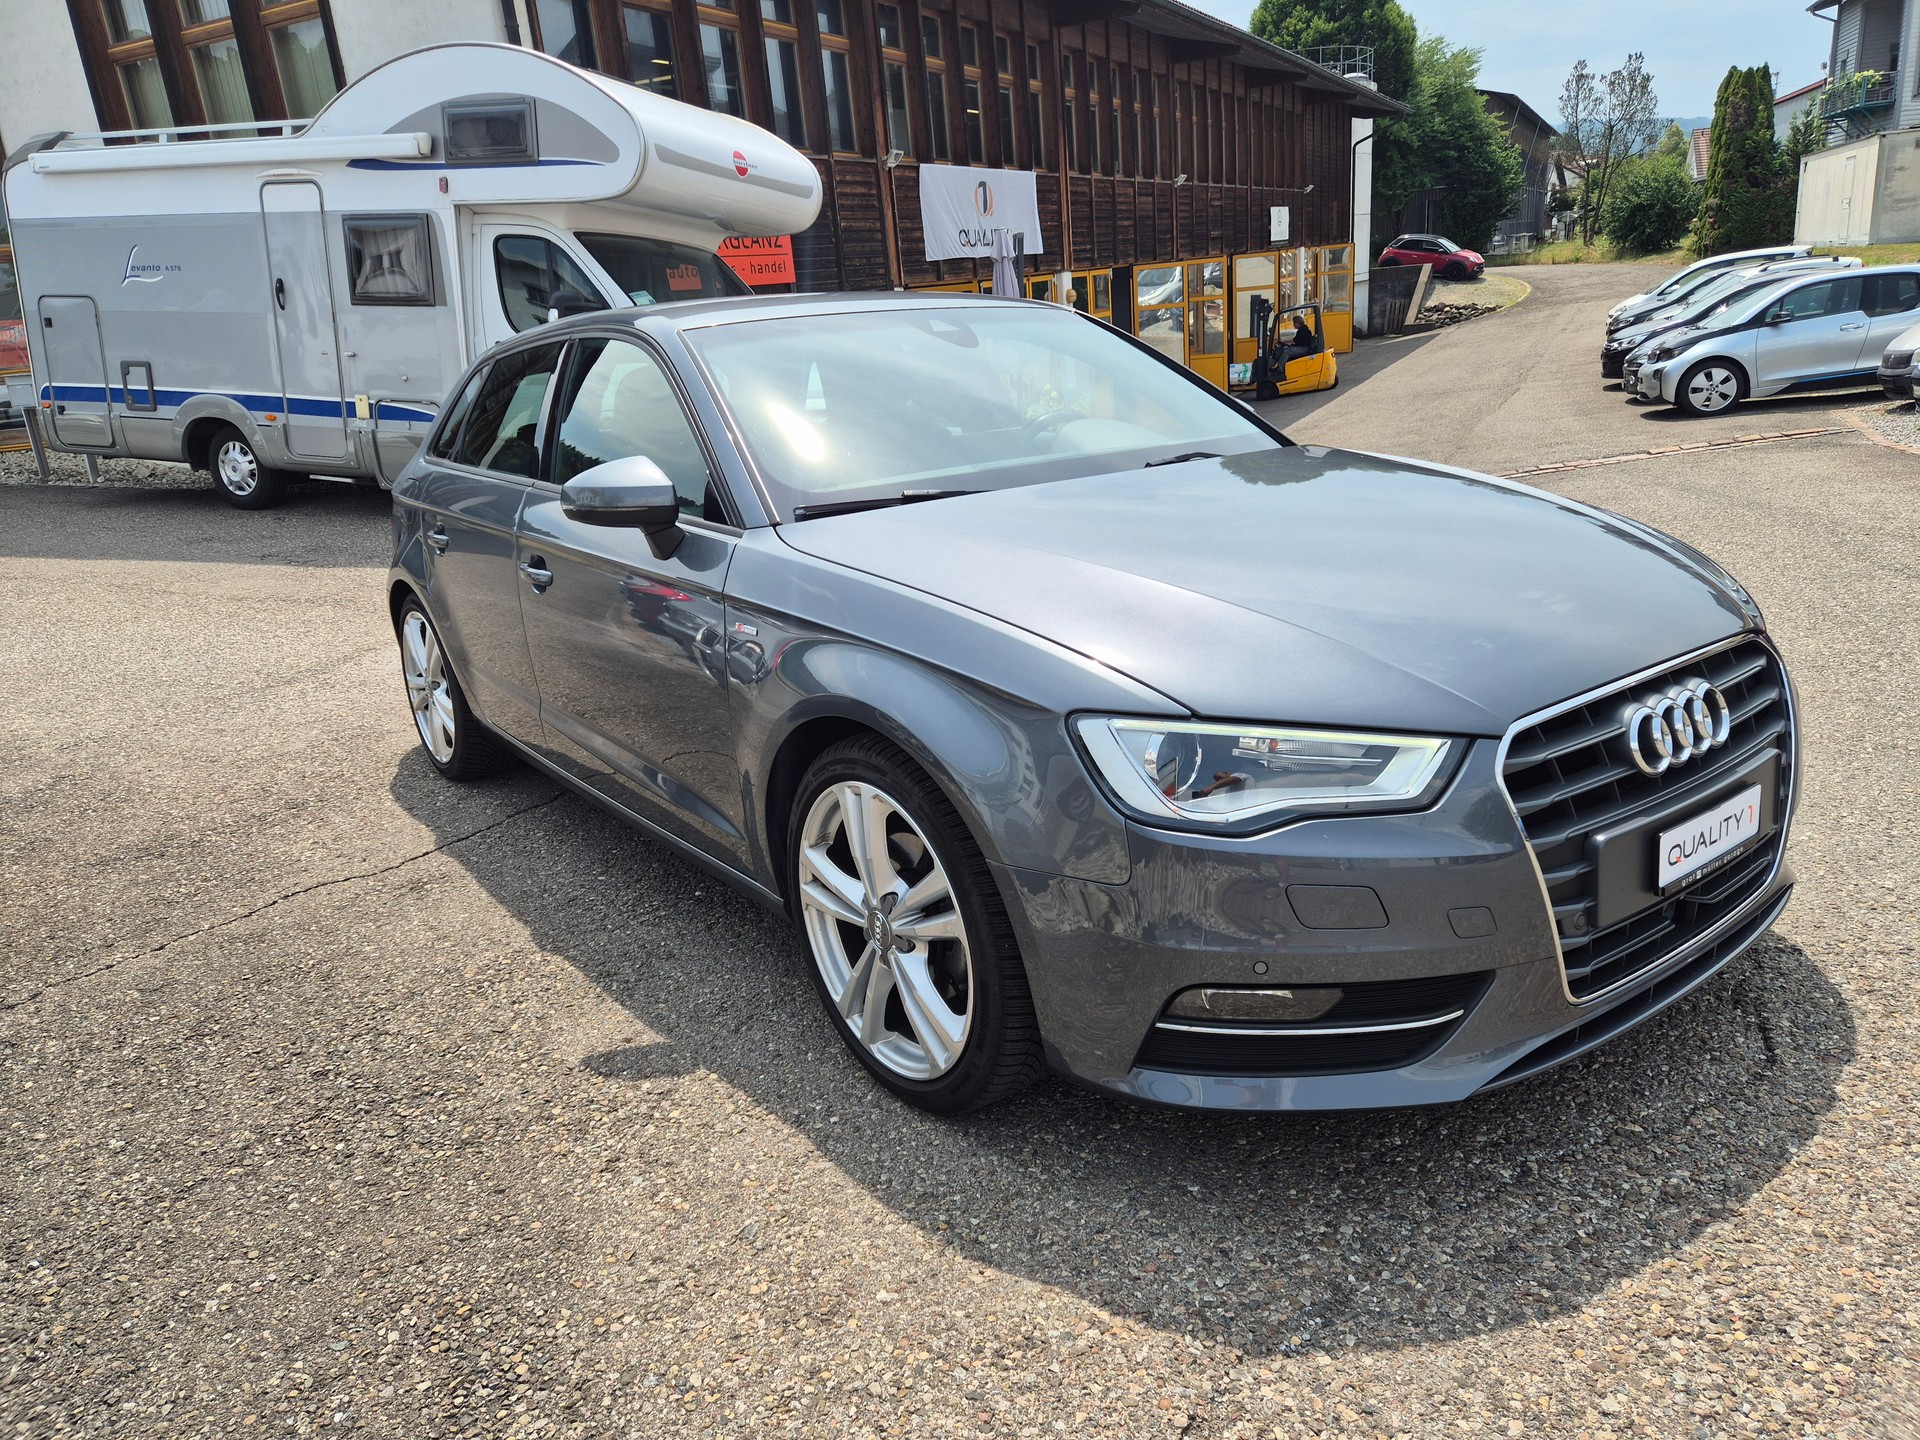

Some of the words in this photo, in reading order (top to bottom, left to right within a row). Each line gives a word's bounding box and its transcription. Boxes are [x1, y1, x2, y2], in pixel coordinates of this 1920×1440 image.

[958, 228, 1010, 248] QUALI
[121, 244, 161, 286] Levanto
[749, 260, 787, 275] handel
[1668, 808, 1744, 867] QUALITY
[1747, 804, 1754, 824] 1
